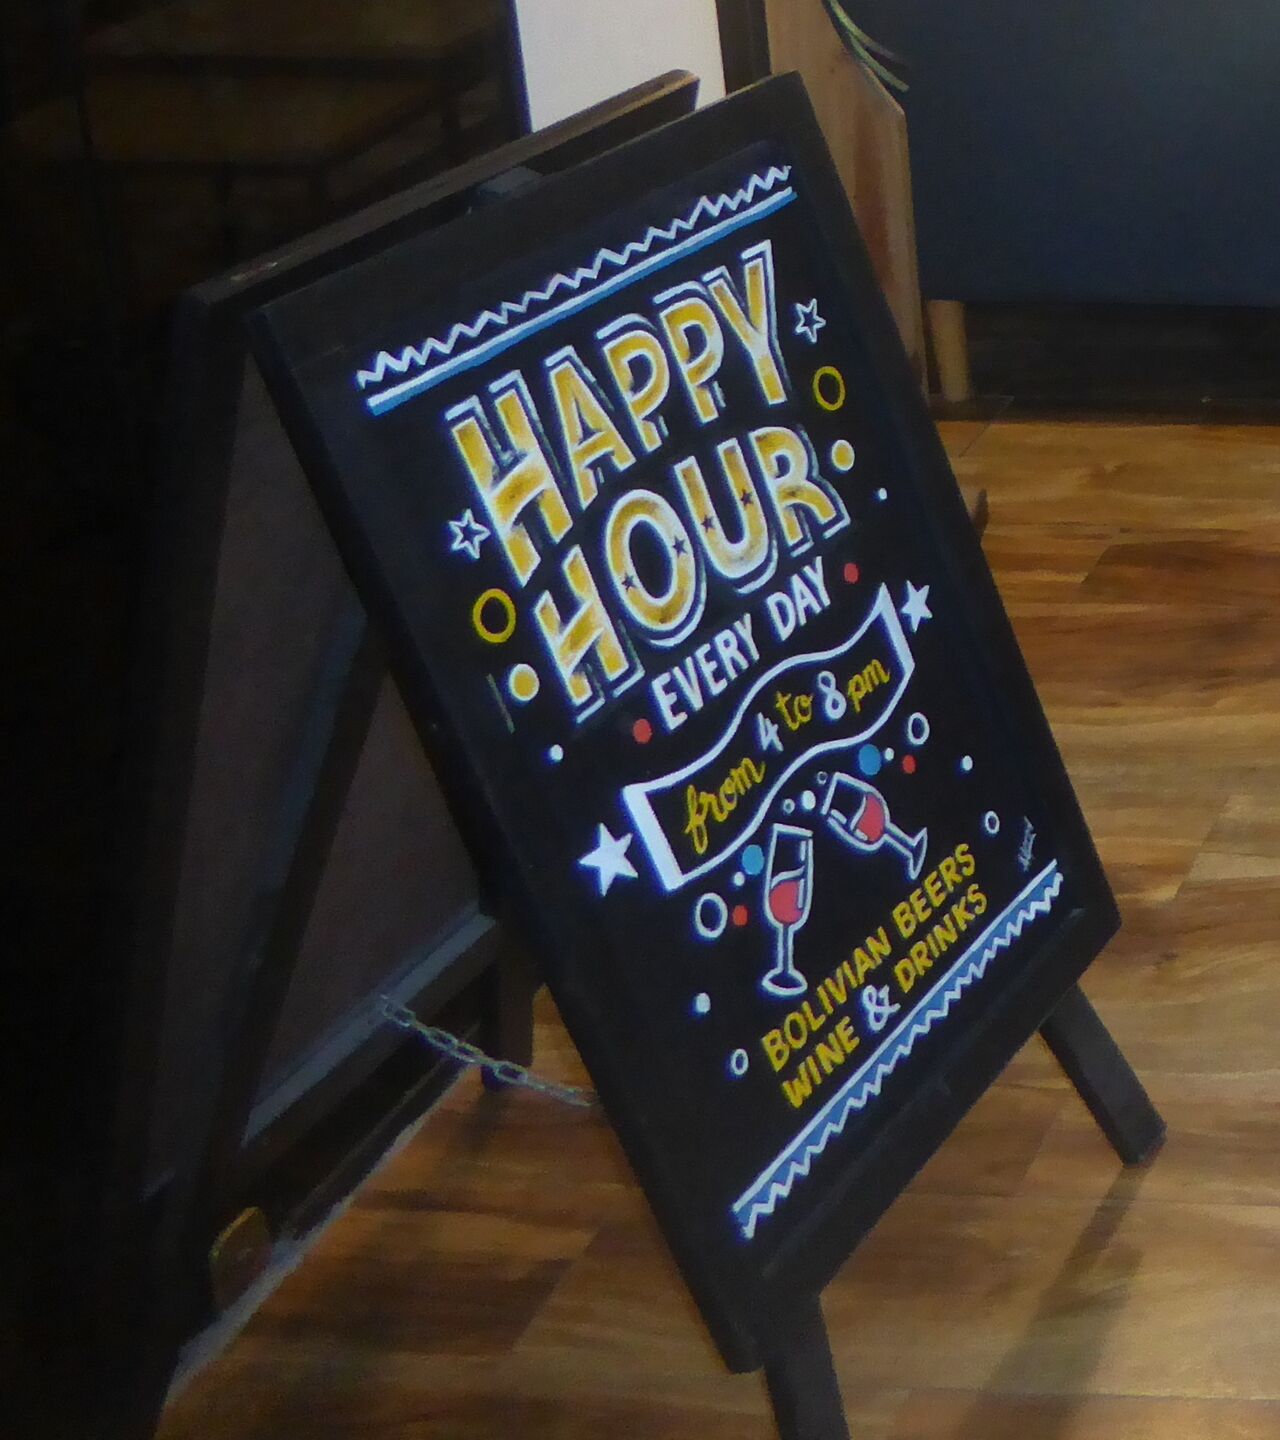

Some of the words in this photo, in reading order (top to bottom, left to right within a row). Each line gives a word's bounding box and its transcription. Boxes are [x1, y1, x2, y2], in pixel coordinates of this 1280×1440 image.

[446, 239, 789, 588] HAPPY
[533, 425, 850, 723] HOUR
[651, 613, 760, 730] EVERY
[766, 556, 831, 642] DAY
[684, 758, 765, 855] from
[757, 712, 784, 752] 4
[775, 691, 813, 731] to
[761, 926, 892, 1072] BOLIVIAN
[892, 843, 976, 939] BEERS
[781, 1016, 860, 1109] WINE
[862, 985, 901, 1032] &
[894, 883, 988, 993] DRINKS
